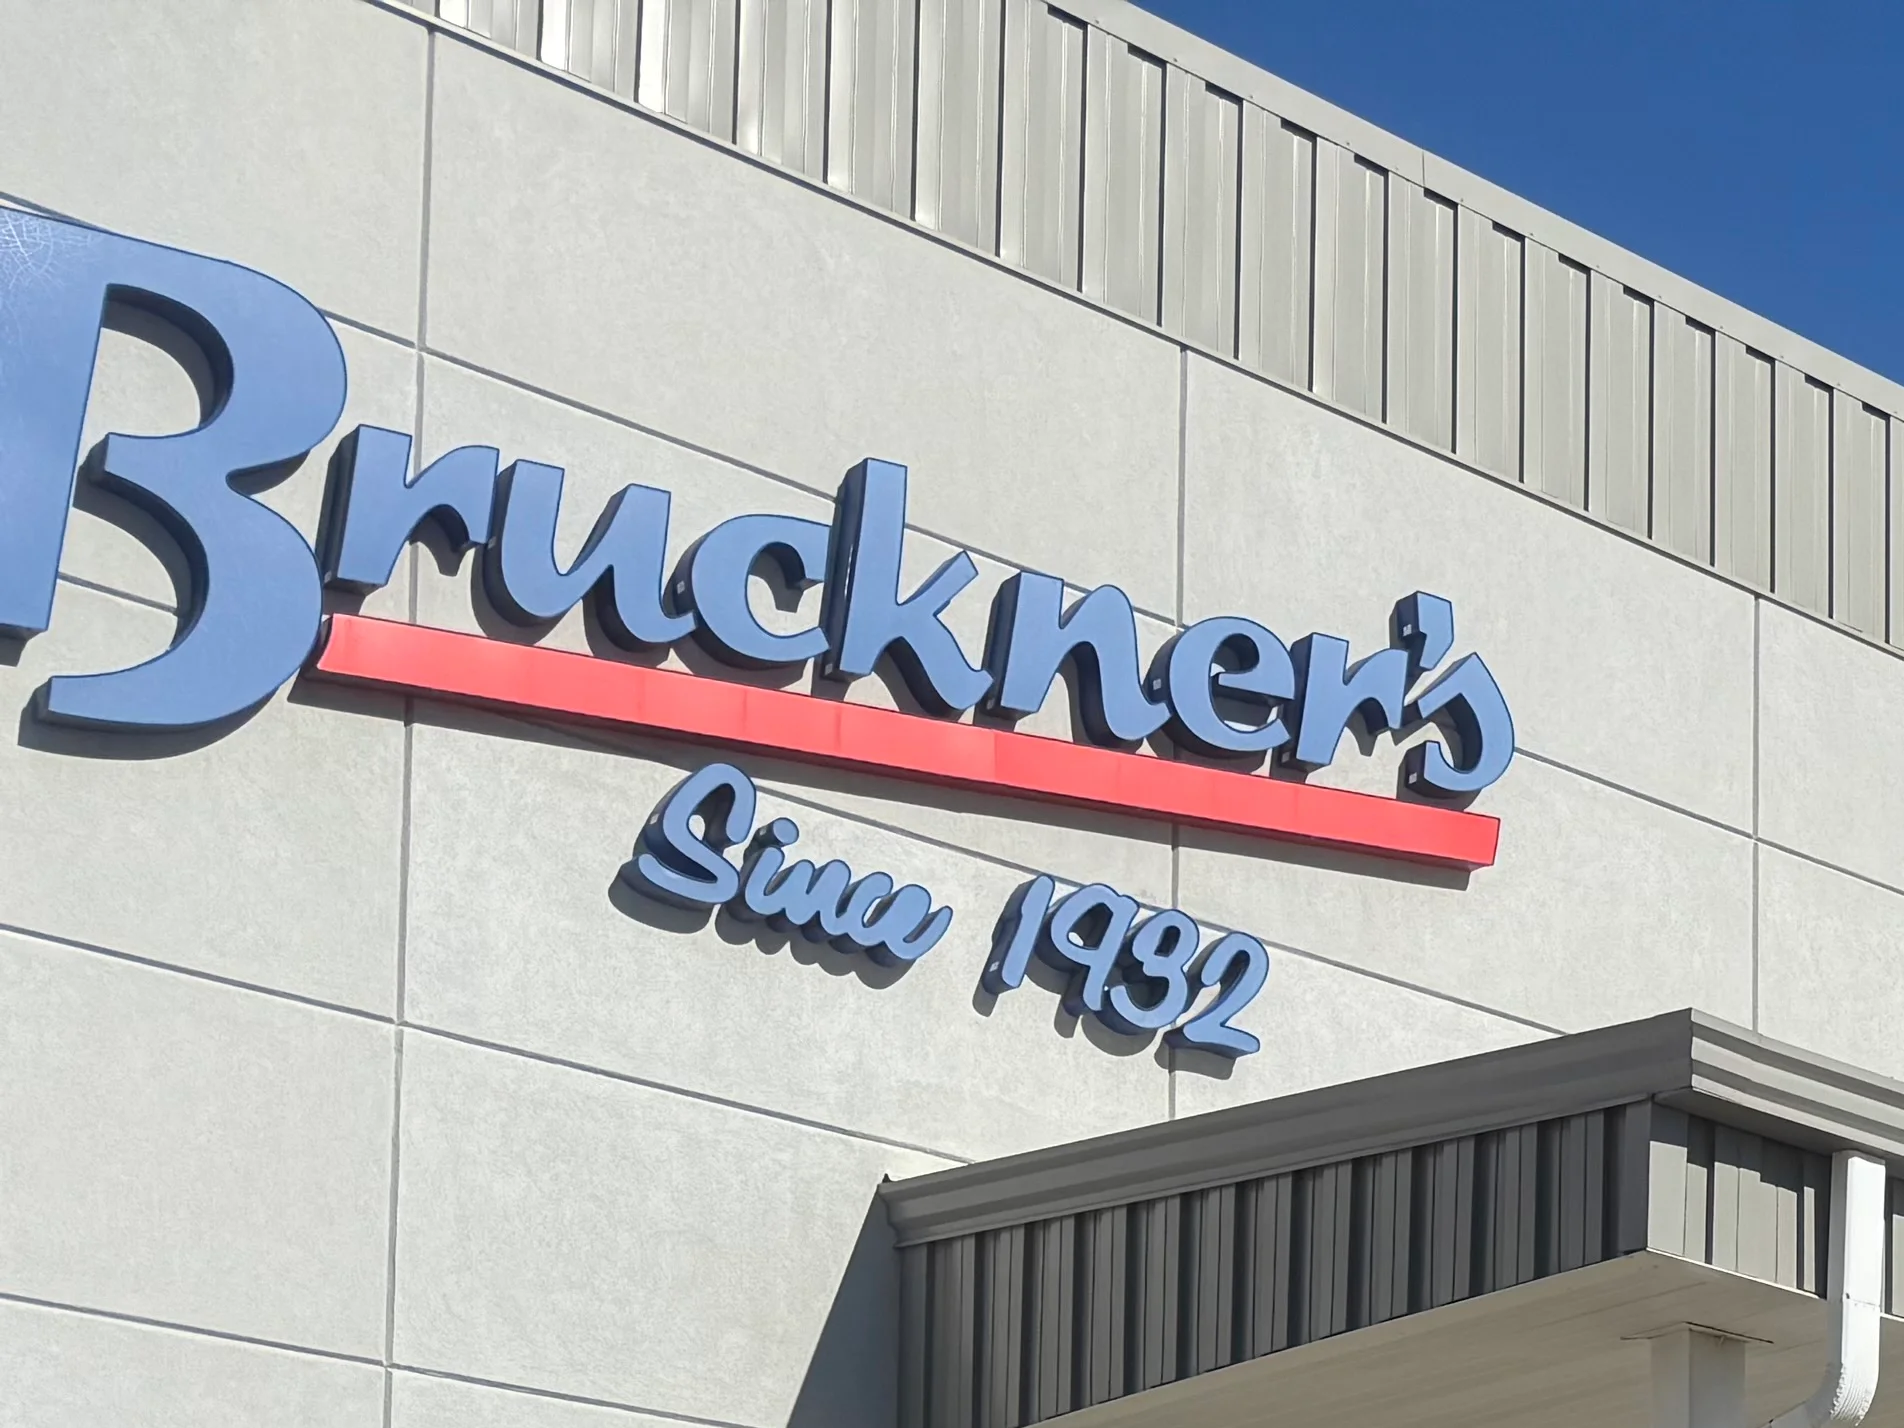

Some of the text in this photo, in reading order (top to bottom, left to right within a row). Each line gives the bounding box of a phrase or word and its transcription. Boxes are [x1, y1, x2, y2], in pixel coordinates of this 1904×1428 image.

[0, 206, 1515, 800] Bruckner's
[630, 762, 1271, 1057] Since 1932
